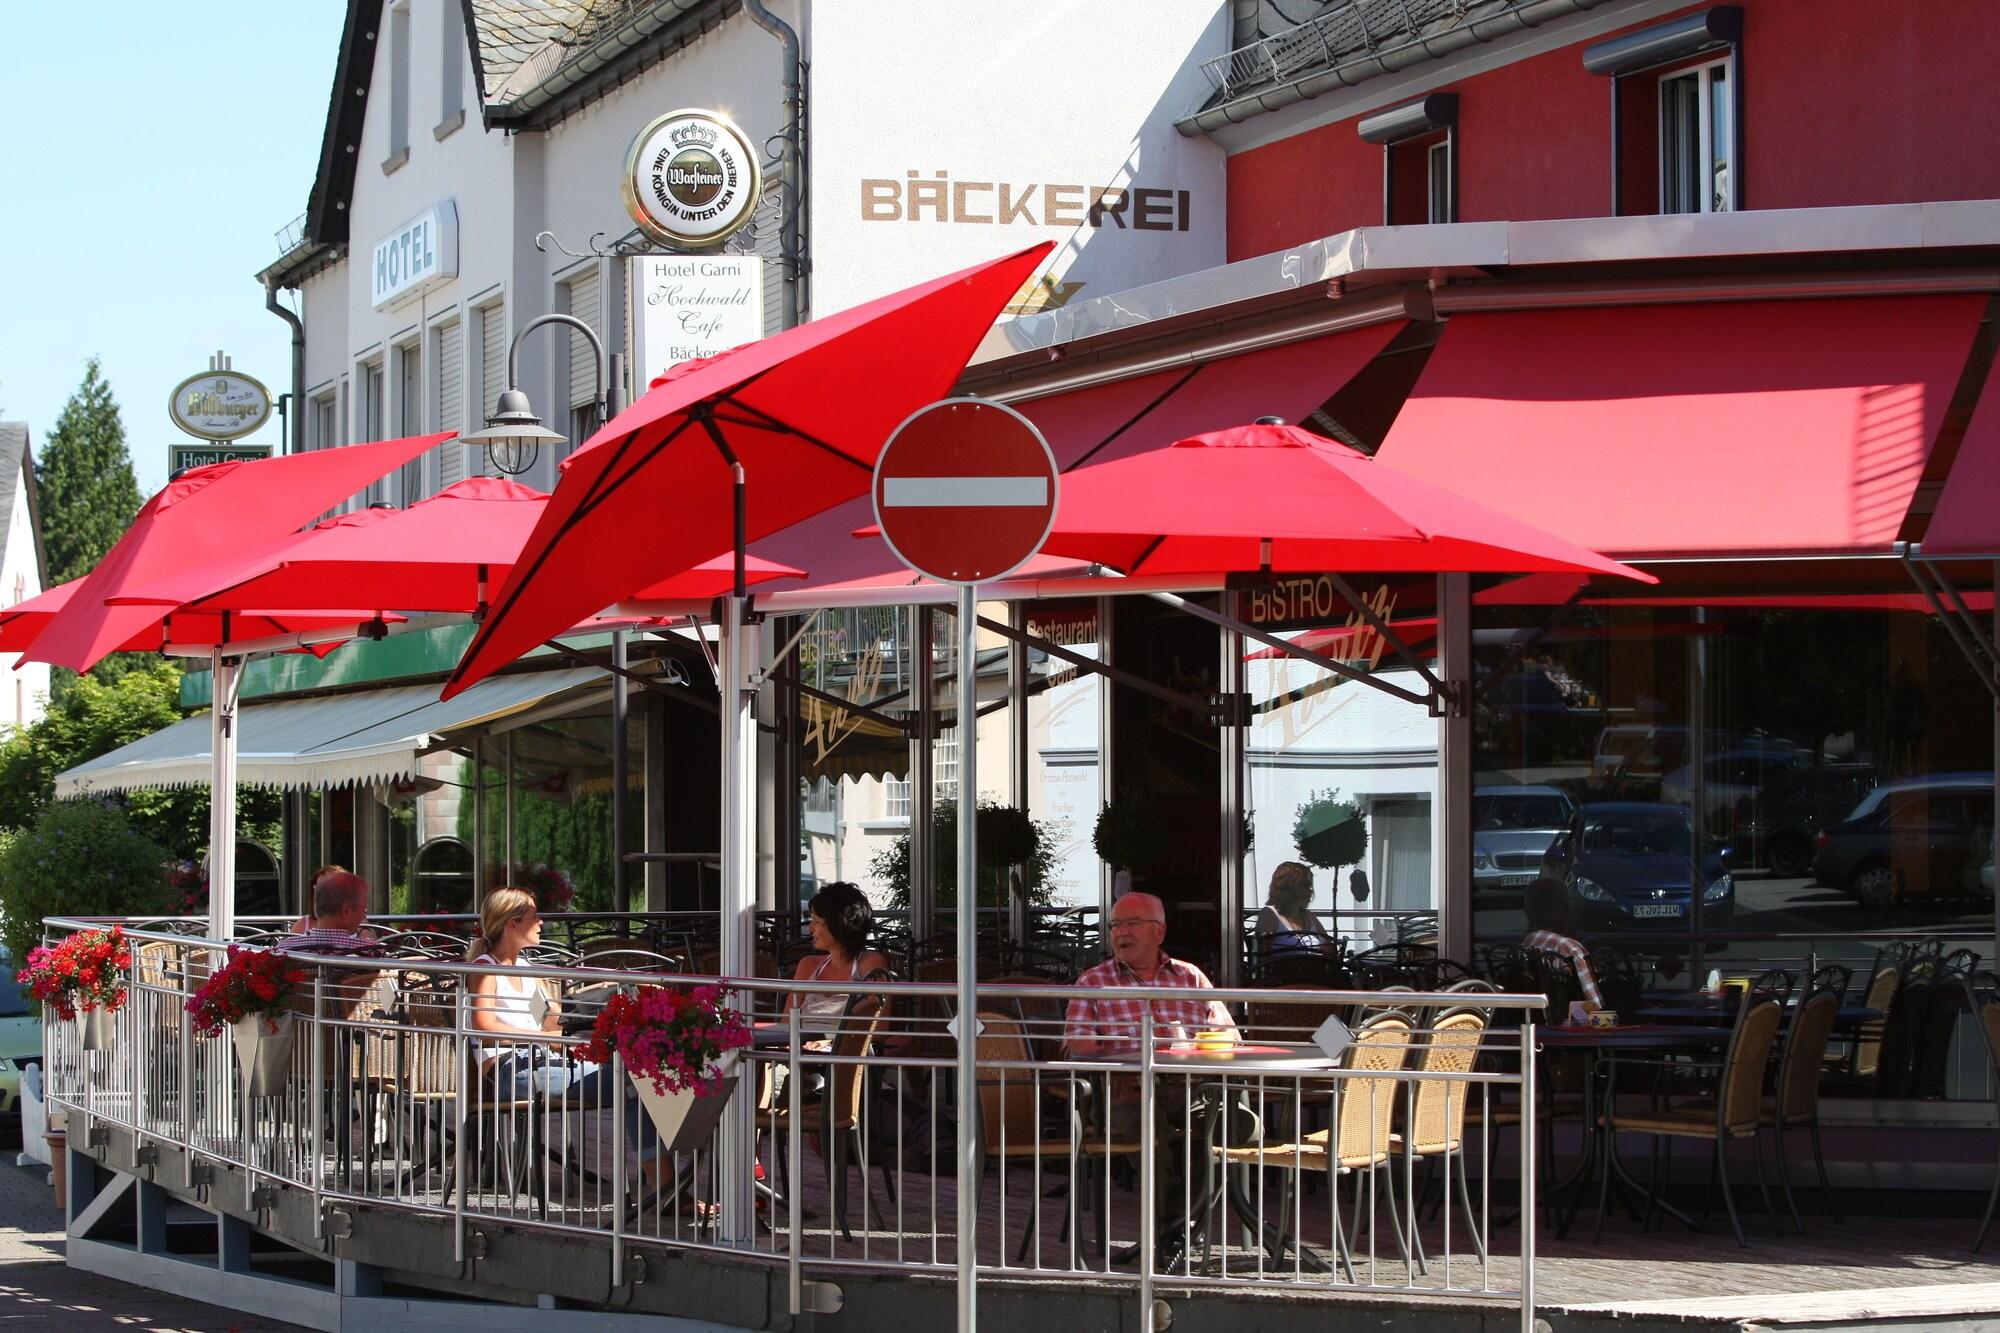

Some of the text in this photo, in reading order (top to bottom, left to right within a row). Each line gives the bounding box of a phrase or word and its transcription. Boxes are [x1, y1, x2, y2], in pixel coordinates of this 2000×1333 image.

[651, 147, 737, 222] EINE KÖNIGIN UNTER DEN BIEREN
[861, 169, 1191, 232] BÄCKEREI
[376, 220, 433, 295] HOTEL
[655, 262, 741, 277] Hotel Garni
[647, 284, 752, 306] Hochwald
[182, 452, 220, 467] Hotel
[1252, 576, 1333, 623] BISTRO
